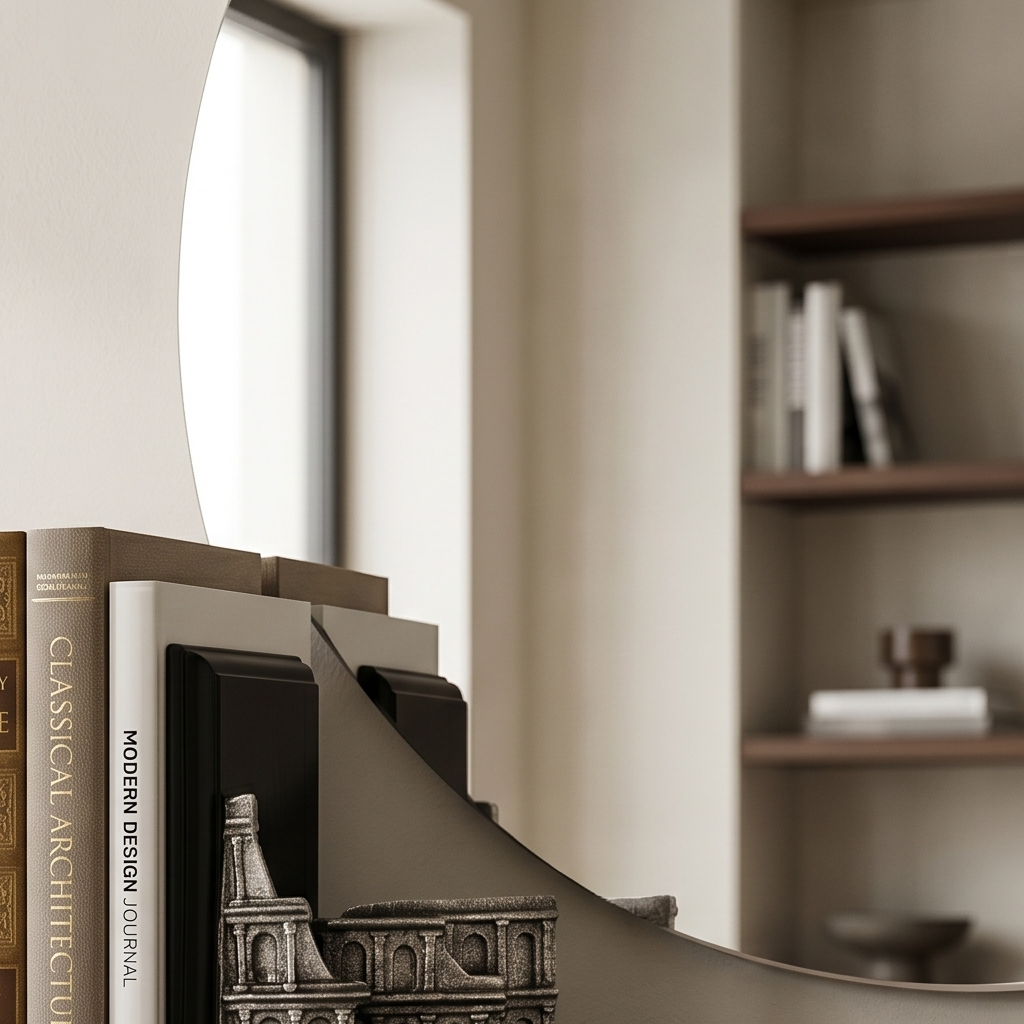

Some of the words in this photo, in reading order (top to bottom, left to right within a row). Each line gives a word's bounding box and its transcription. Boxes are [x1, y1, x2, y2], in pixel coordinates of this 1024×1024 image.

[49, 636, 73, 806] CLASSICAL
[123, 730, 138, 814] MODERN
[123, 821, 138, 892] DESIGN
[123, 898, 138, 988] JOURNAL
